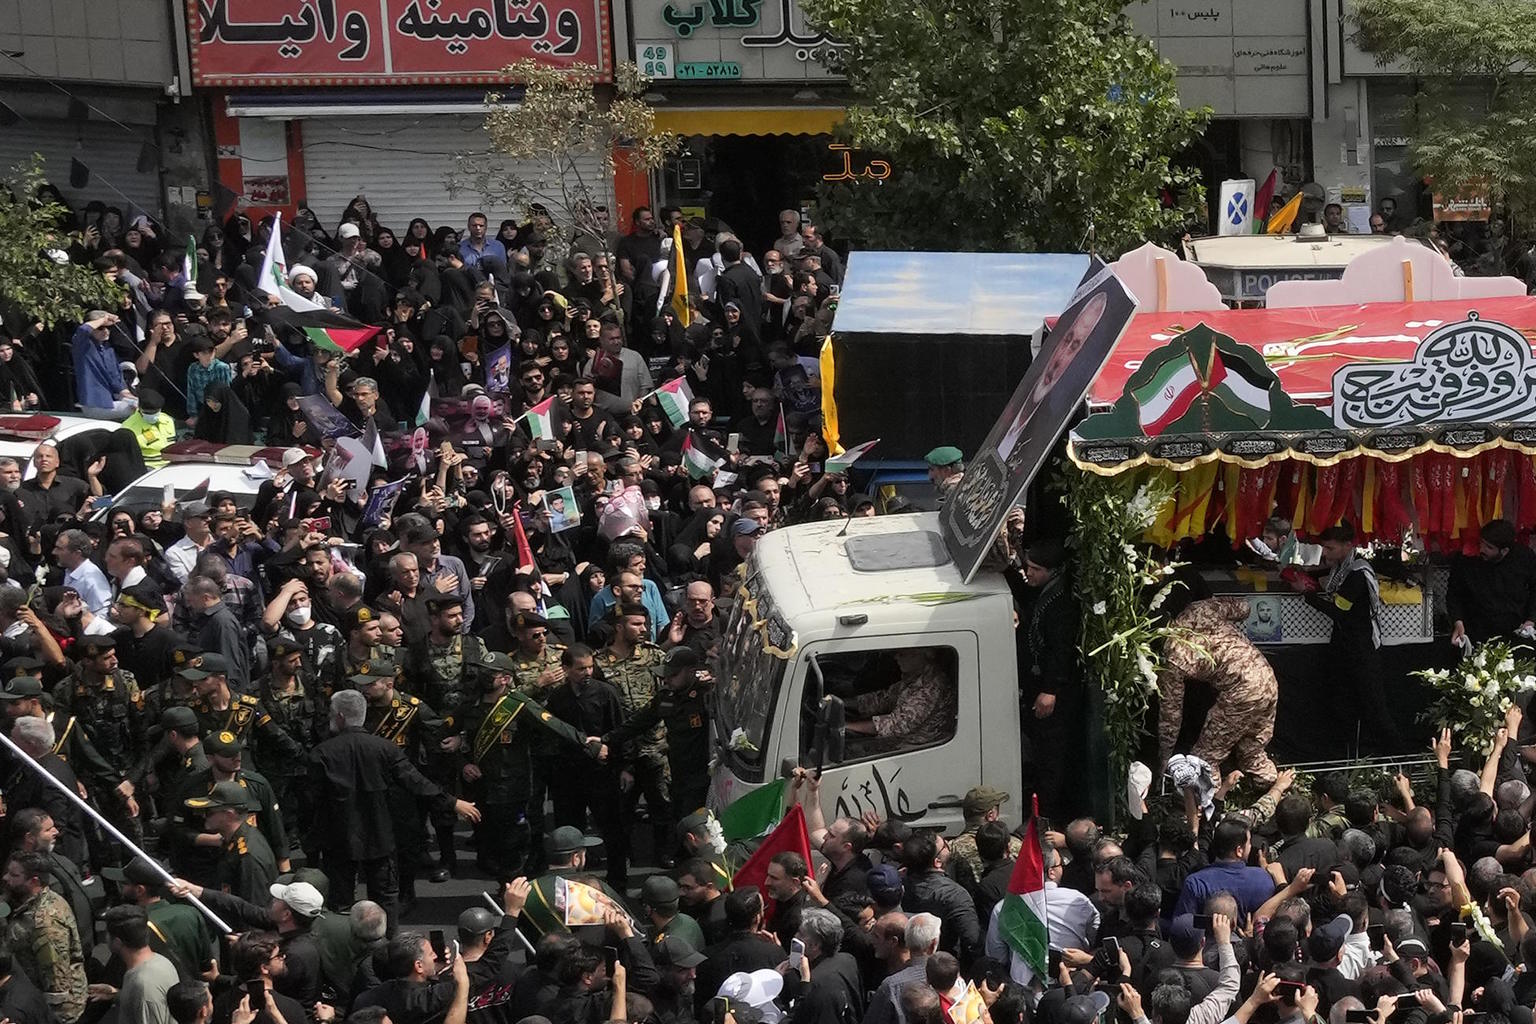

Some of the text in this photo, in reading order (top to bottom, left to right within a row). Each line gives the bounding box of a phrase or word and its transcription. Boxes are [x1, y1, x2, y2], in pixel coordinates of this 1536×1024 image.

[1188, 8, 1220, 21] پلیس
[396, 0, 581, 55] ویتامینه
[643, 46, 667, 60] 49
